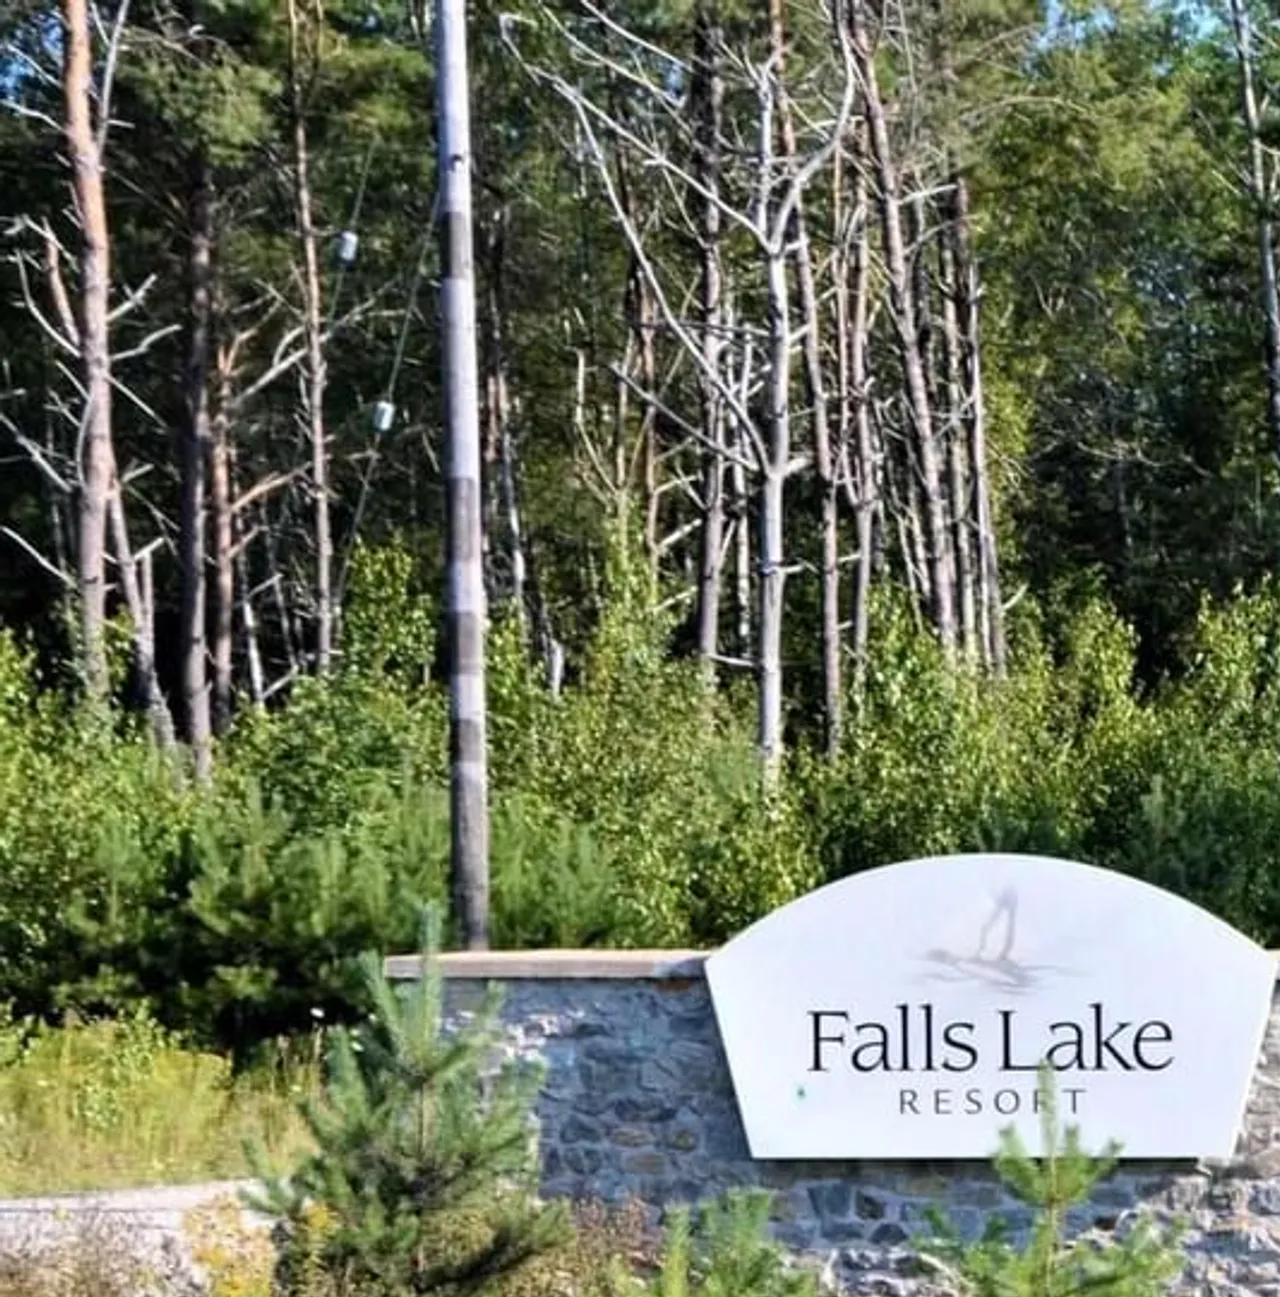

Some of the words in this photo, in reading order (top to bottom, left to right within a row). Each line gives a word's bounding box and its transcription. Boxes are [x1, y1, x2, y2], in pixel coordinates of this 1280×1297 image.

[807, 1003, 978, 1072] Falls
[998, 1002, 1174, 1072] Lake
[899, 1088, 1086, 1115] RESOT
